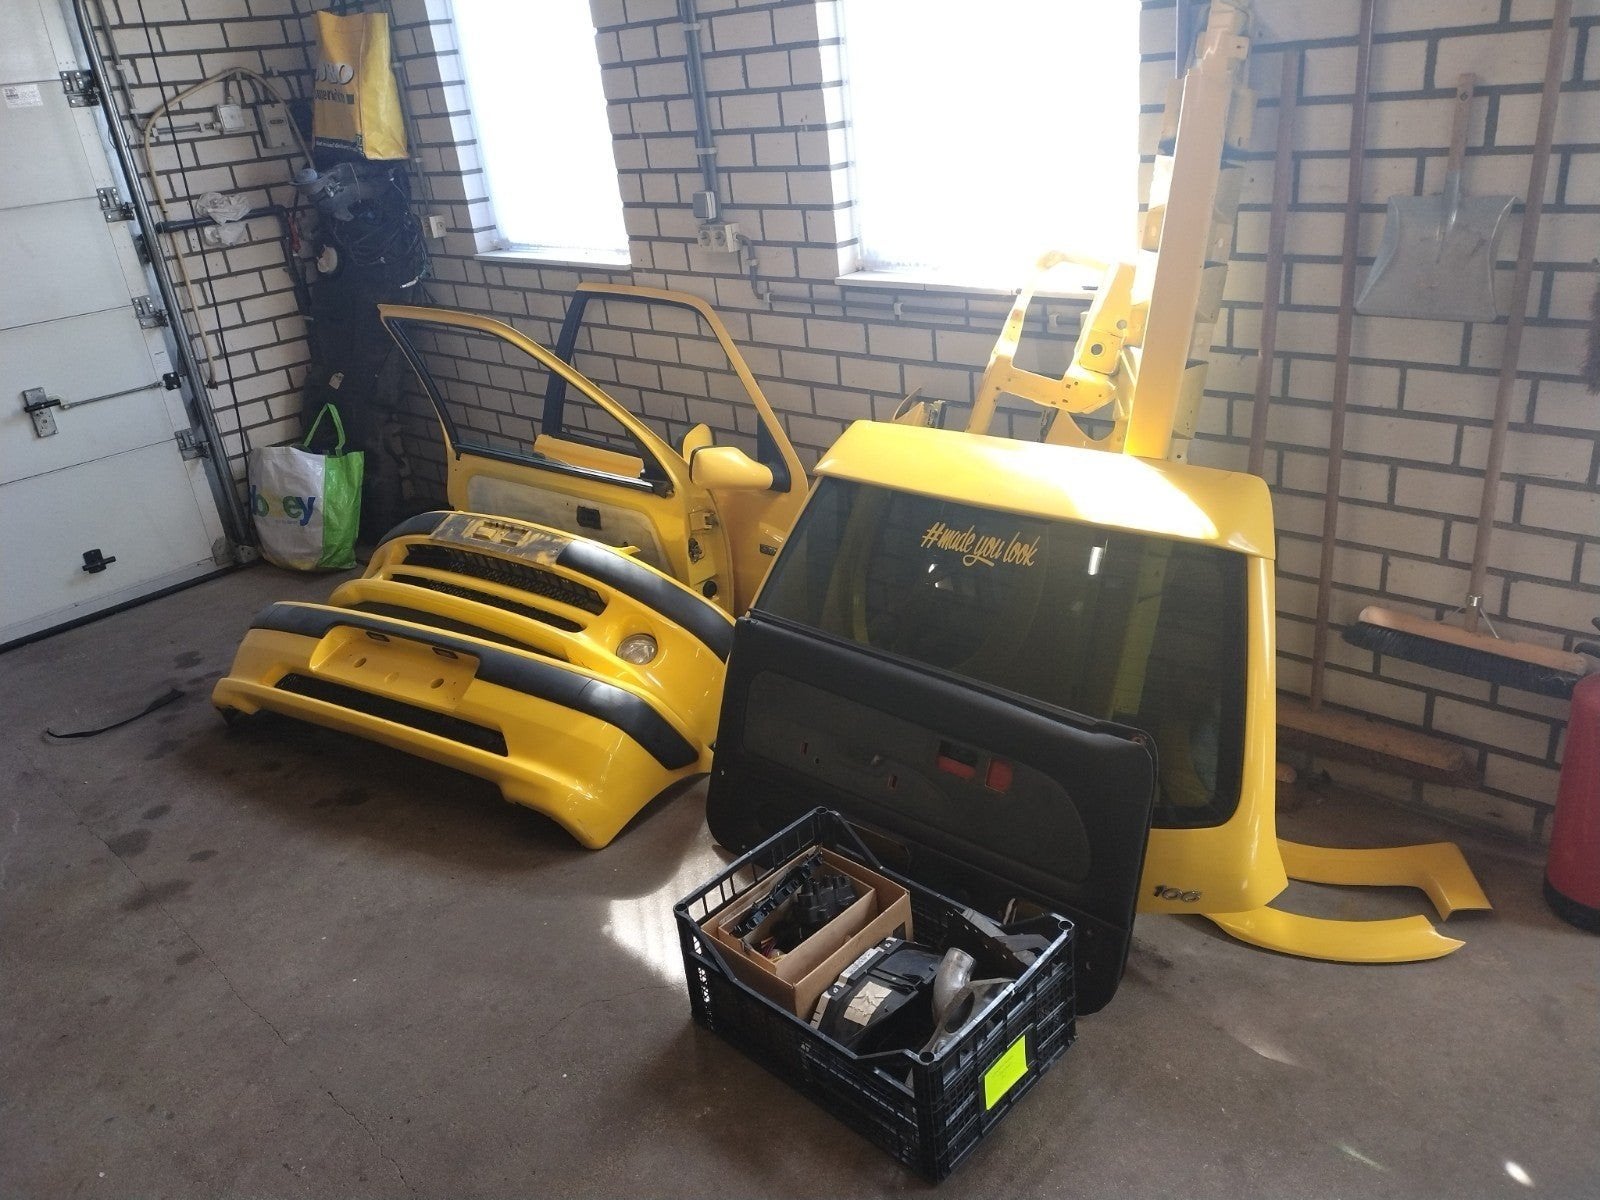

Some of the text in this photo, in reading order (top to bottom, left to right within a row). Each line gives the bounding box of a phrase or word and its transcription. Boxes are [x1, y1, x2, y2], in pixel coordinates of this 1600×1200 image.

[920, 522, 1041, 567] #made you look
[1153, 885, 1201, 903] 106
